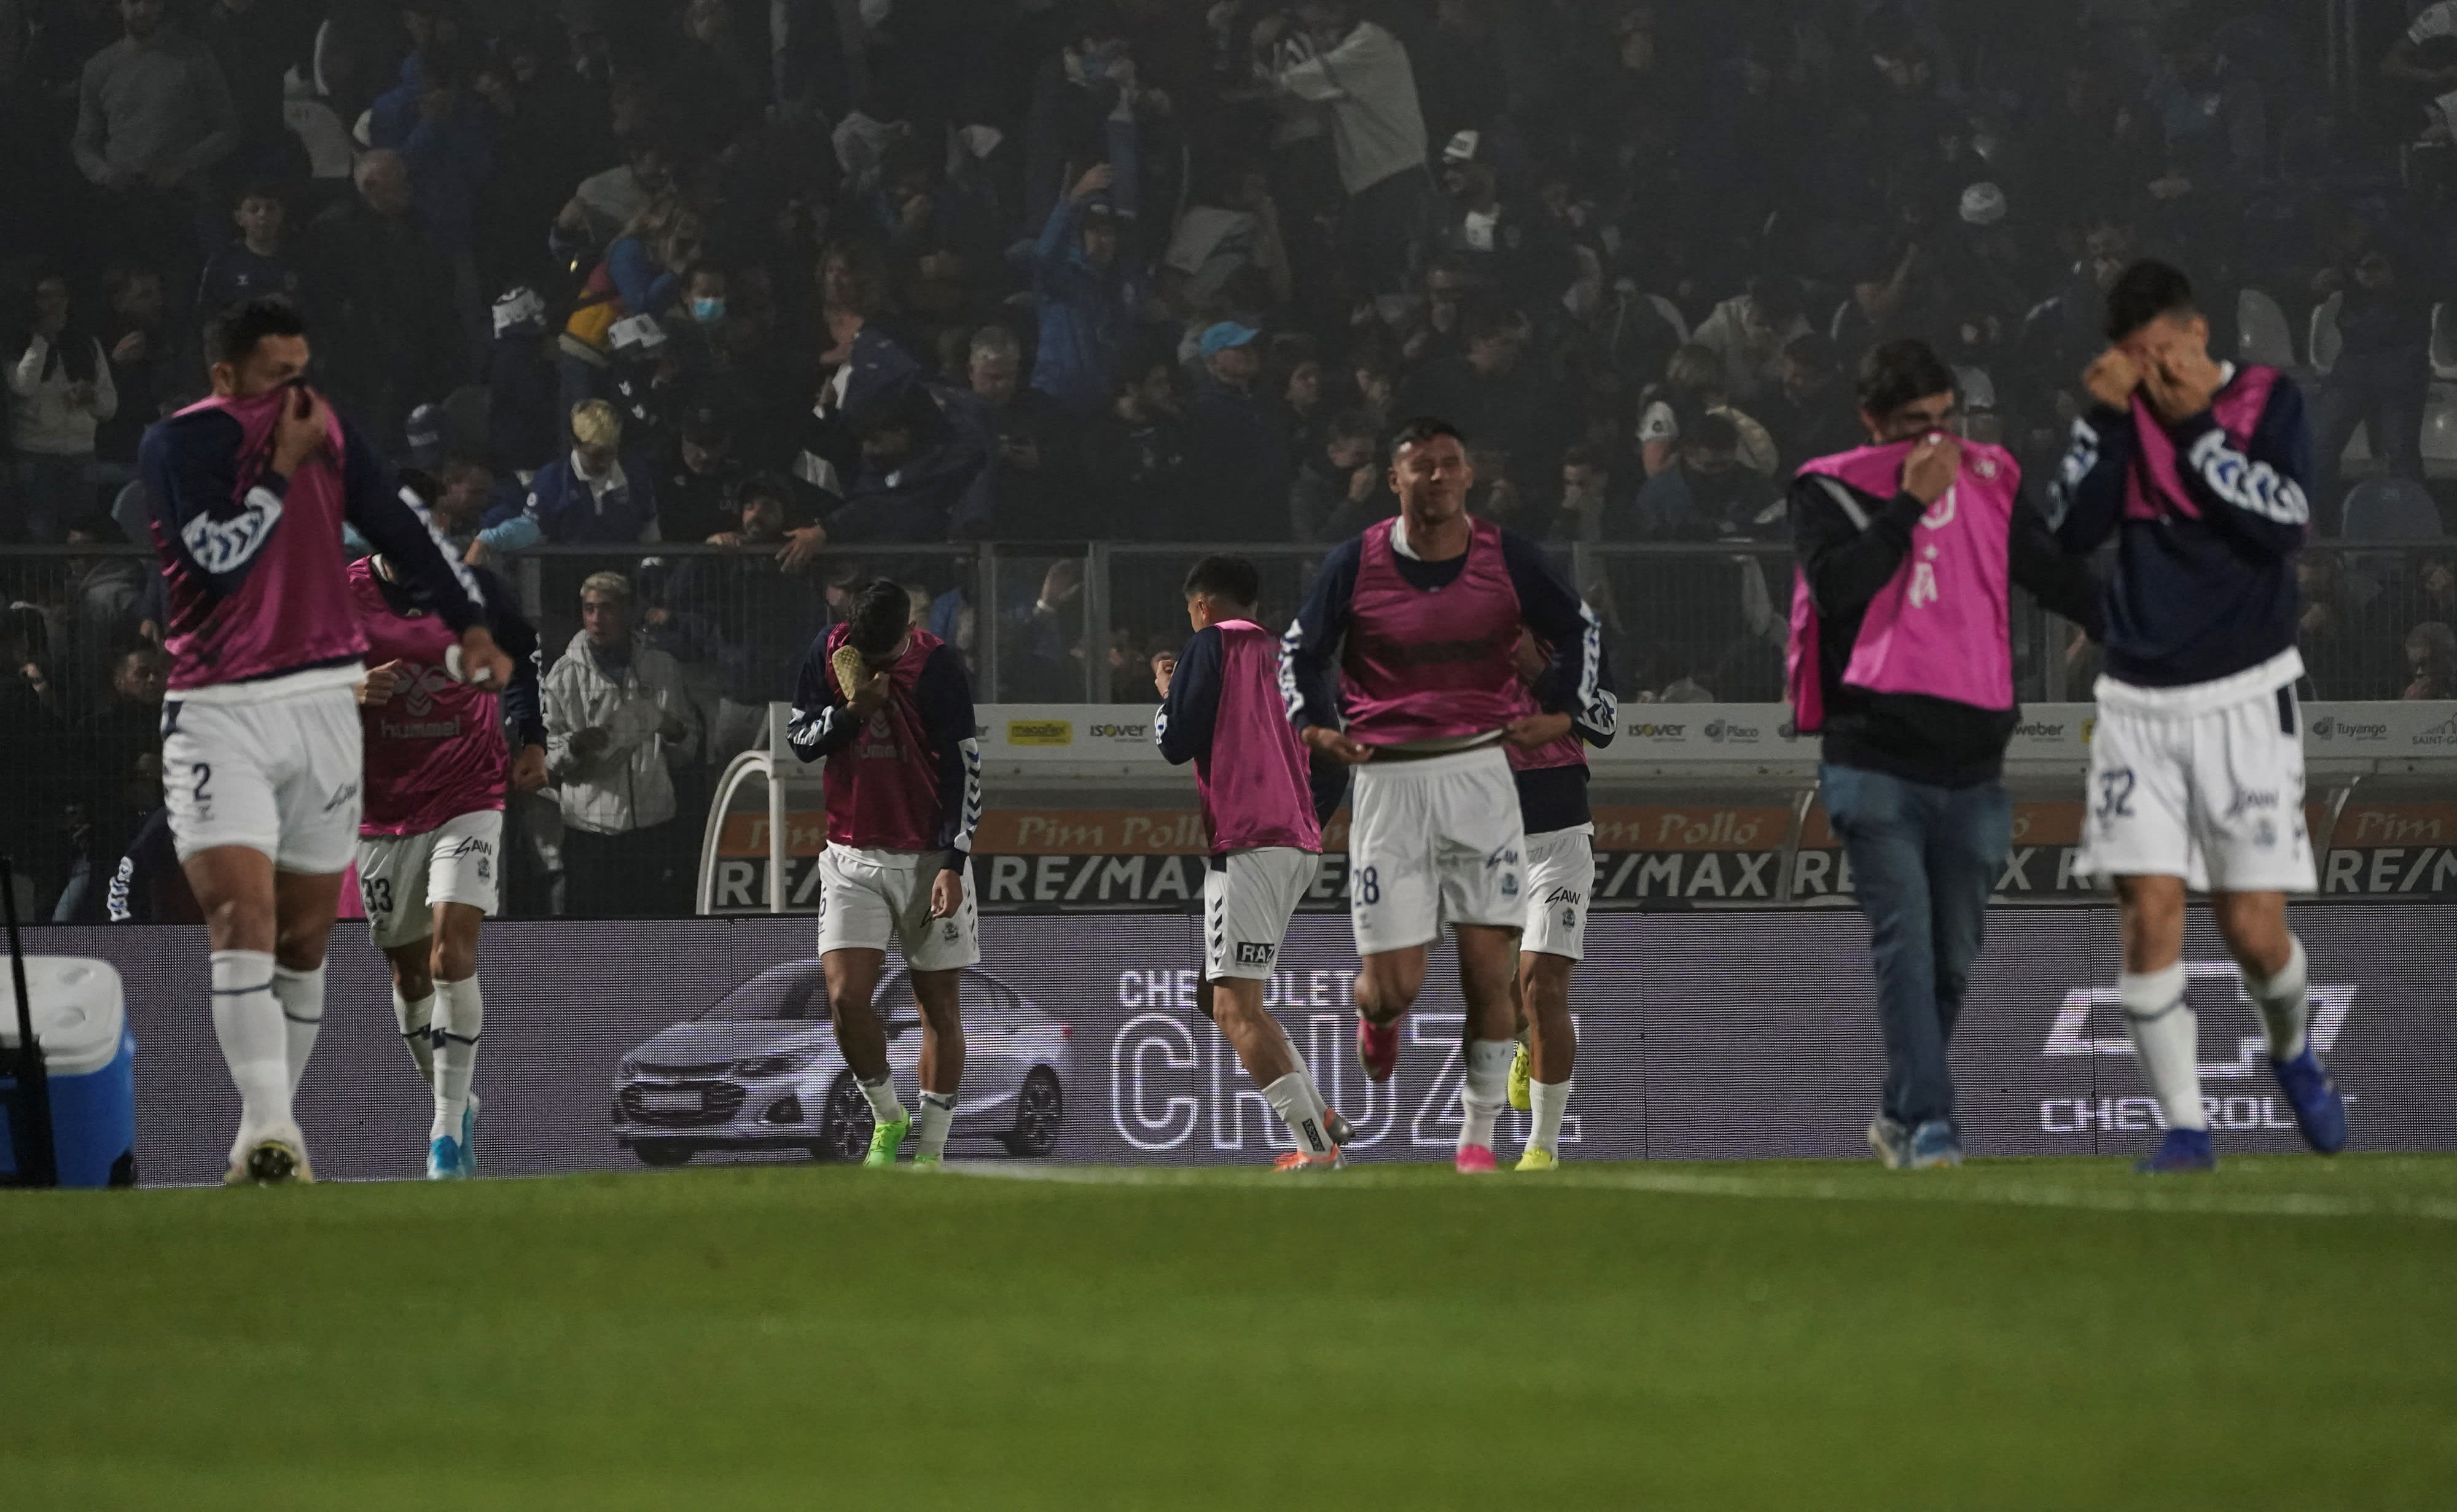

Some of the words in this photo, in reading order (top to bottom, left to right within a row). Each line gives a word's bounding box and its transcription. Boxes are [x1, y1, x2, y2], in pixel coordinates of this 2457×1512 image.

[191, 762, 212, 801] 2
[1017, 816, 1105, 848] Pim
[2354, 810, 2443, 841] Pim
[453, 836, 492, 865] SAW
[2325, 848, 2457, 892] RE/M
[1544, 886, 1581, 918] SAW
